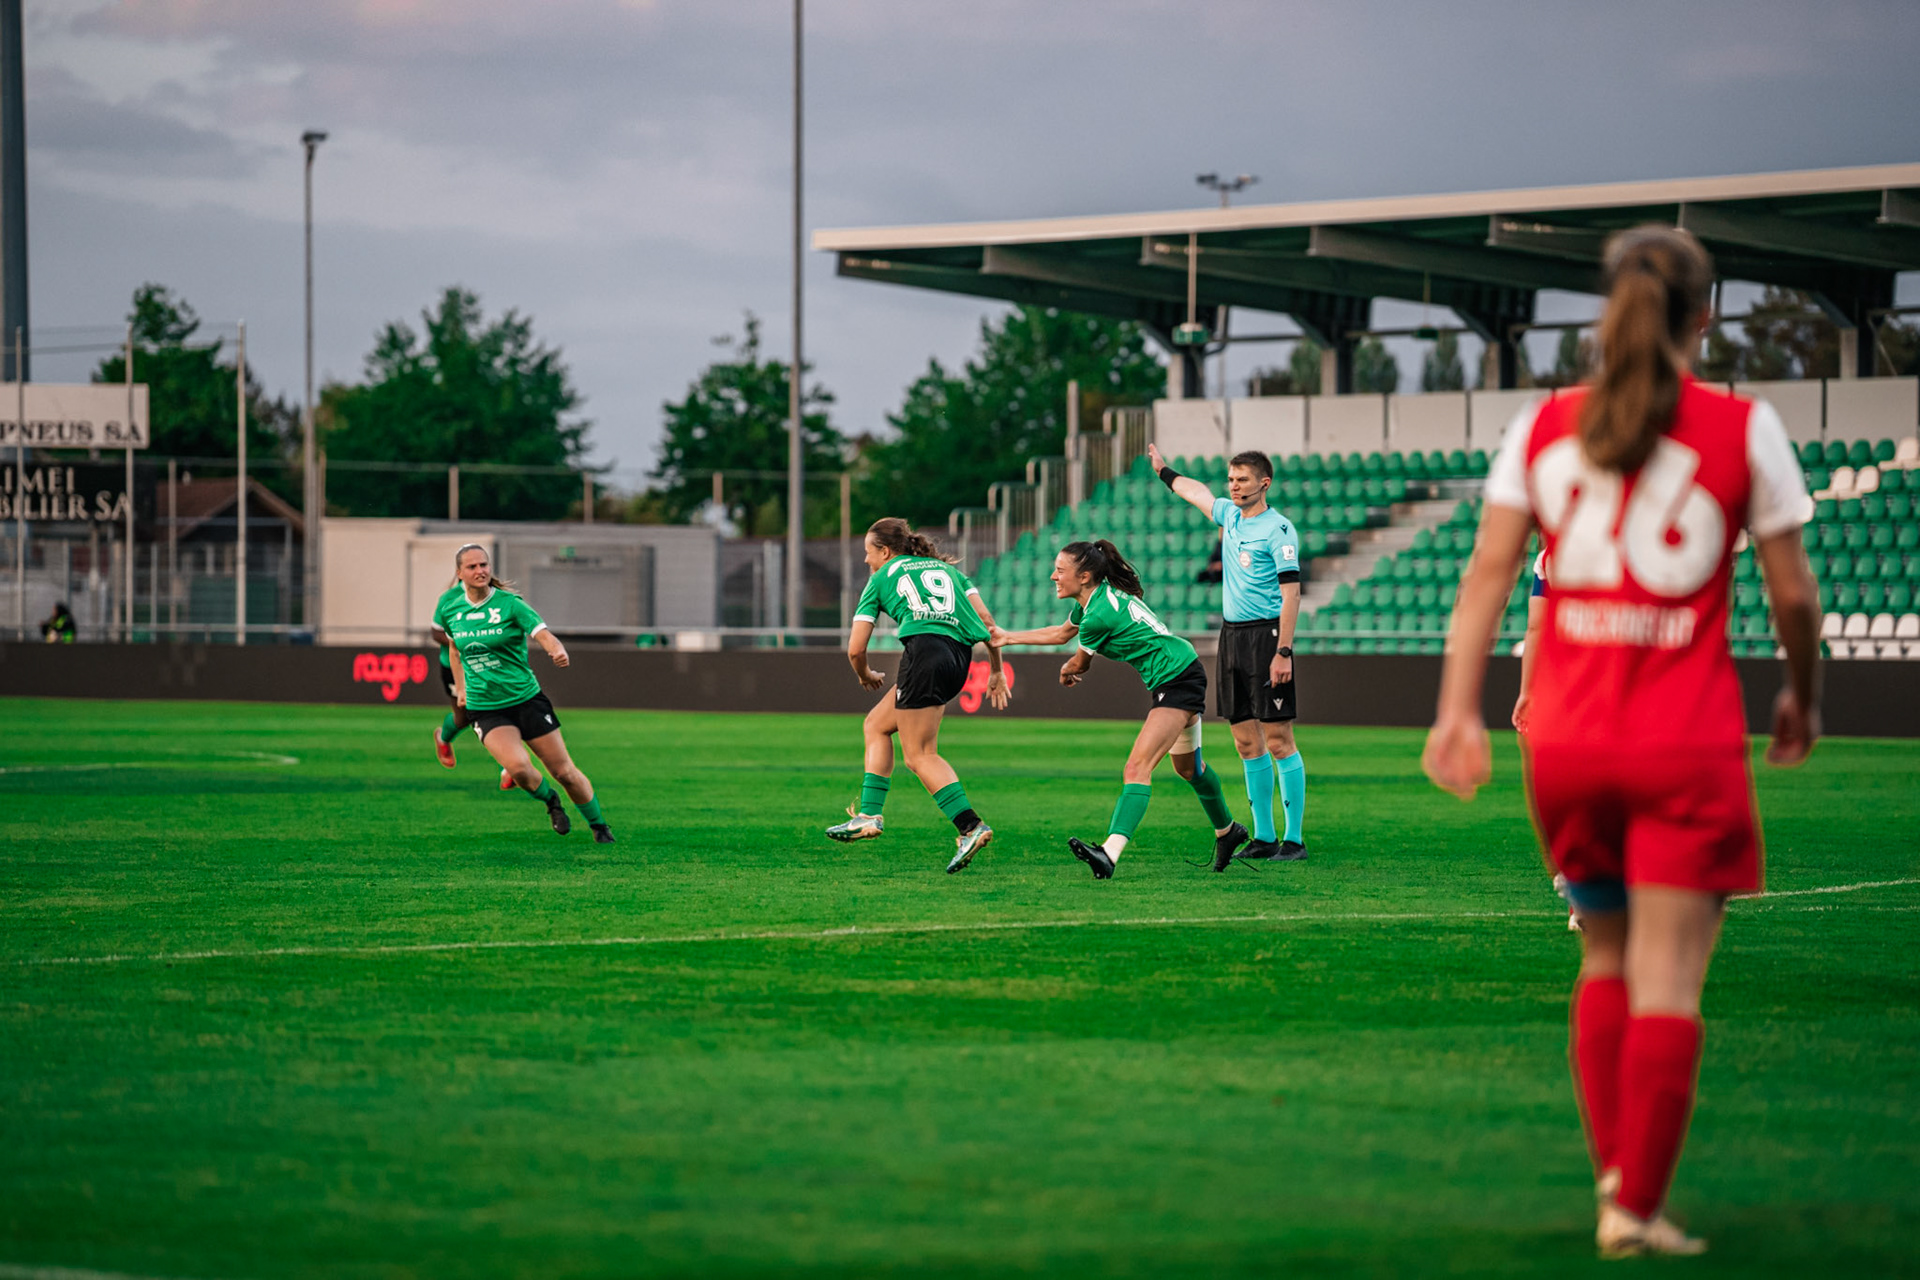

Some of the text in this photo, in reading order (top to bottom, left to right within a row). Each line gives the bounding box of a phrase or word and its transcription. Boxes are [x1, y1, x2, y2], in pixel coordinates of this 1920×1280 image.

[105, 420, 141, 441] SA
[0, 466, 75, 494] IMEI
[1531, 434, 1728, 598] 26
[896, 569, 956, 615] 19
[1127, 595, 1173, 636] 1
